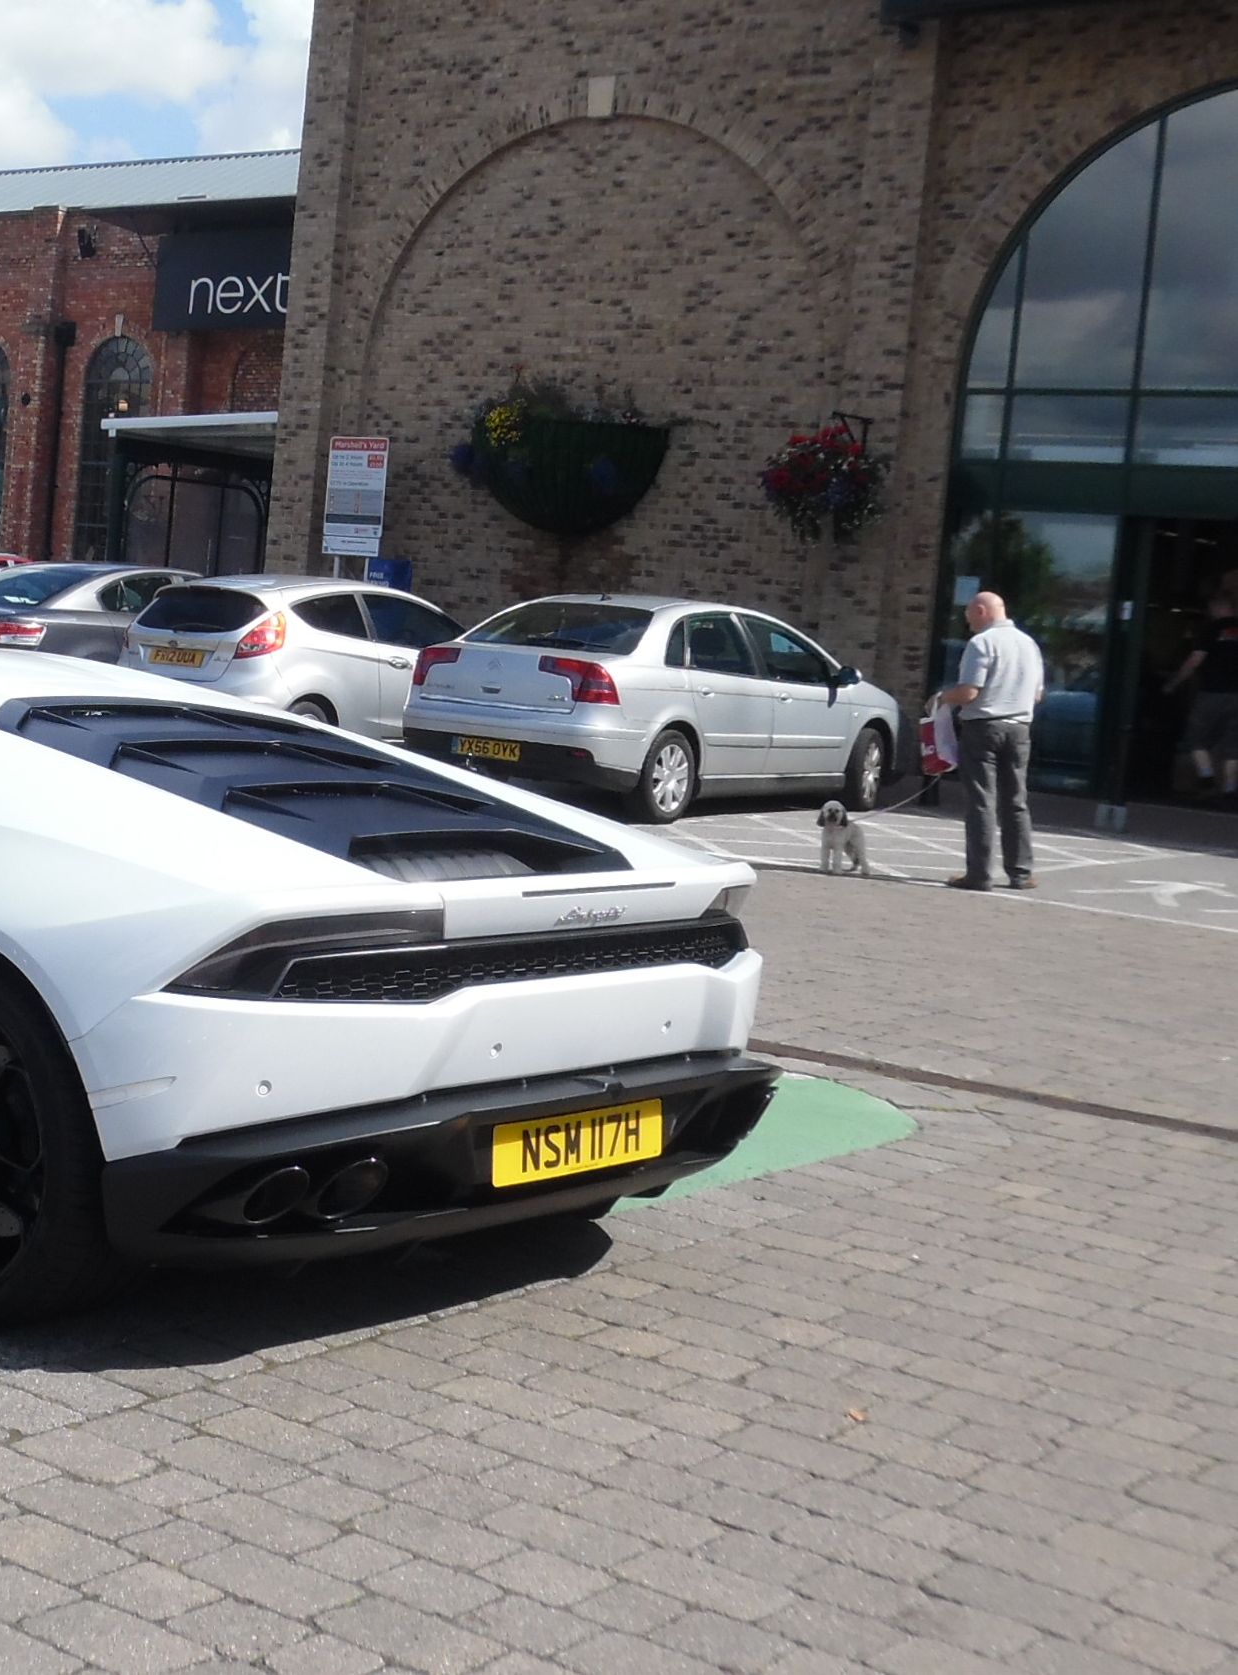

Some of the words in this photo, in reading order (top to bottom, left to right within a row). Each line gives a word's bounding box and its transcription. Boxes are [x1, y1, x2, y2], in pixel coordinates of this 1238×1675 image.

[188, 272, 290, 315] next
[459, 739, 490, 756] YX56
[493, 742, 519, 759] OYK
[521, 1120, 582, 1173] NSM
[590, 1110, 640, 1161] 117H
